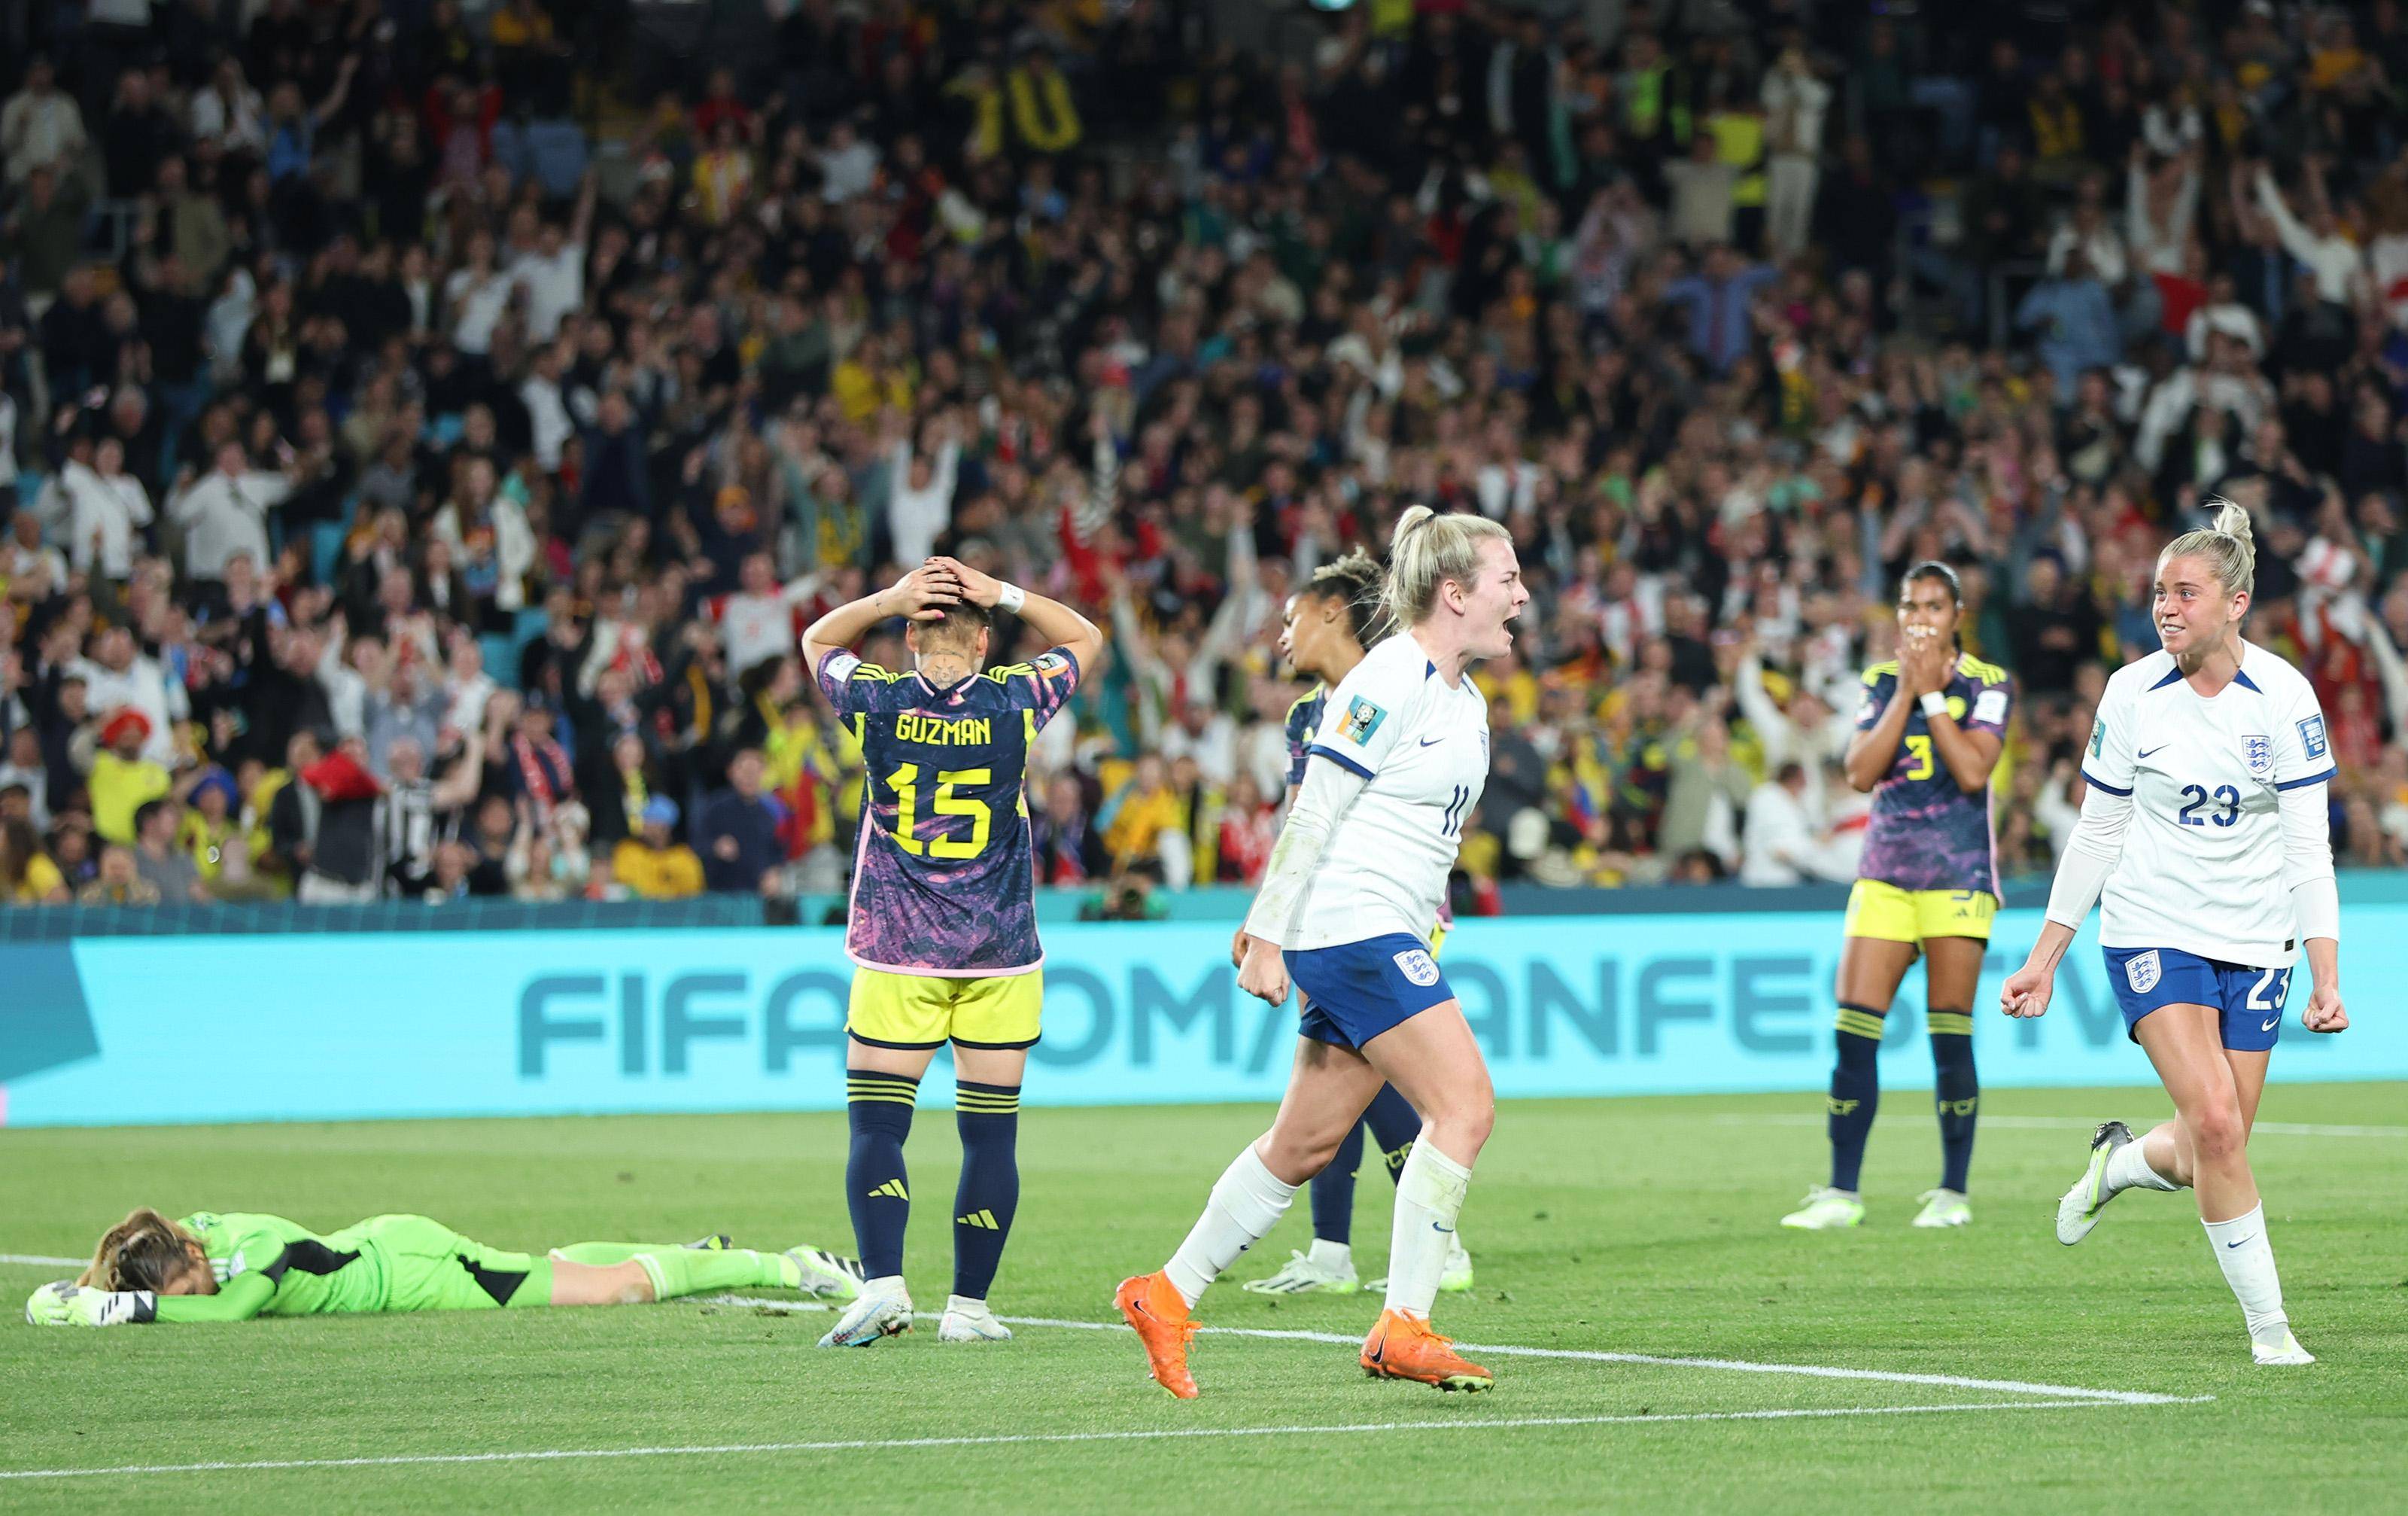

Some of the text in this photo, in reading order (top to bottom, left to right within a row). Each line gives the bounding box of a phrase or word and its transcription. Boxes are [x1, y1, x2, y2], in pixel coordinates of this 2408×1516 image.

[895, 714, 991, 746] GUZMAN
[1905, 735, 1934, 781] 3
[886, 762, 991, 859] 15
[1442, 784, 1469, 837] 11
[2179, 784, 2239, 826] 23
[2246, 967, 2290, 1009] 23
